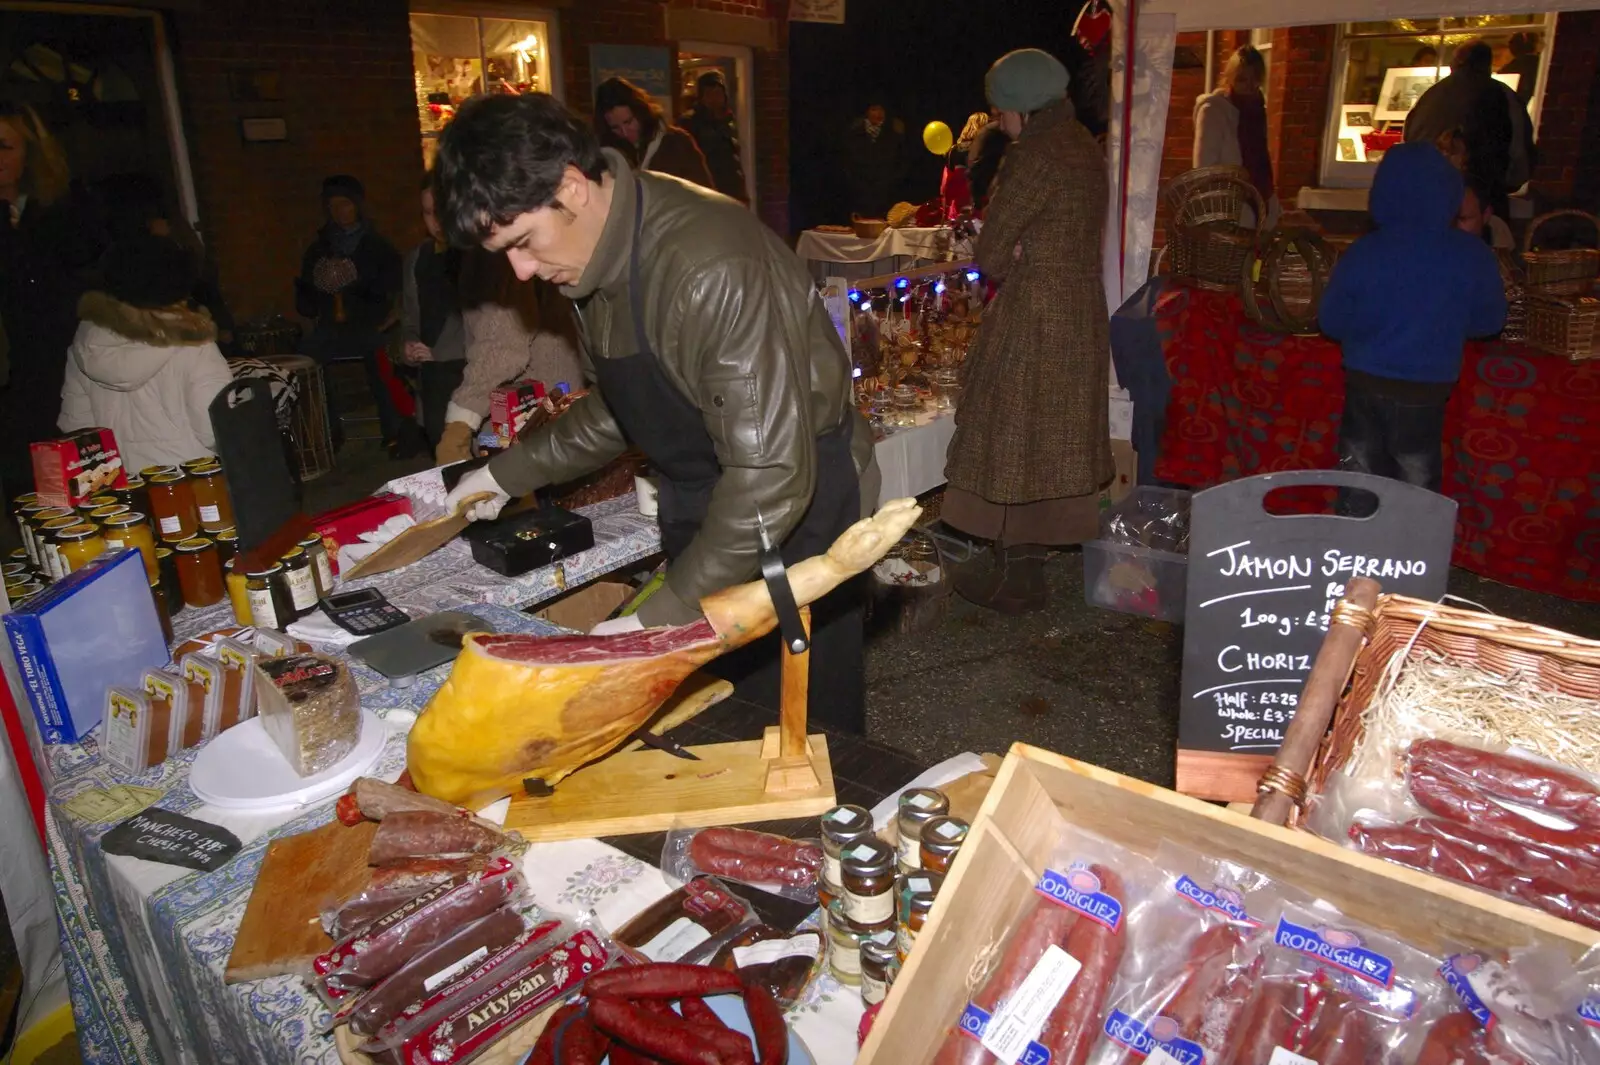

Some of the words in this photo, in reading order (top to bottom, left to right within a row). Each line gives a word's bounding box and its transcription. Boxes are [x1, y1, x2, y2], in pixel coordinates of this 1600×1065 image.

[1206, 540, 1312, 579] JAMON
[1321, 550, 1427, 578] SERRANO
[21, 656, 35, 678] TORO
[1218, 645, 1311, 673] CHORIZ
[128, 815, 199, 840] MANCHEGO
[136, 834, 182, 852] CHEESE
[378, 880, 455, 926] Artysán
[1280, 931, 1388, 980] RODRIGUEZ
[466, 973, 547, 1032] Artysán
